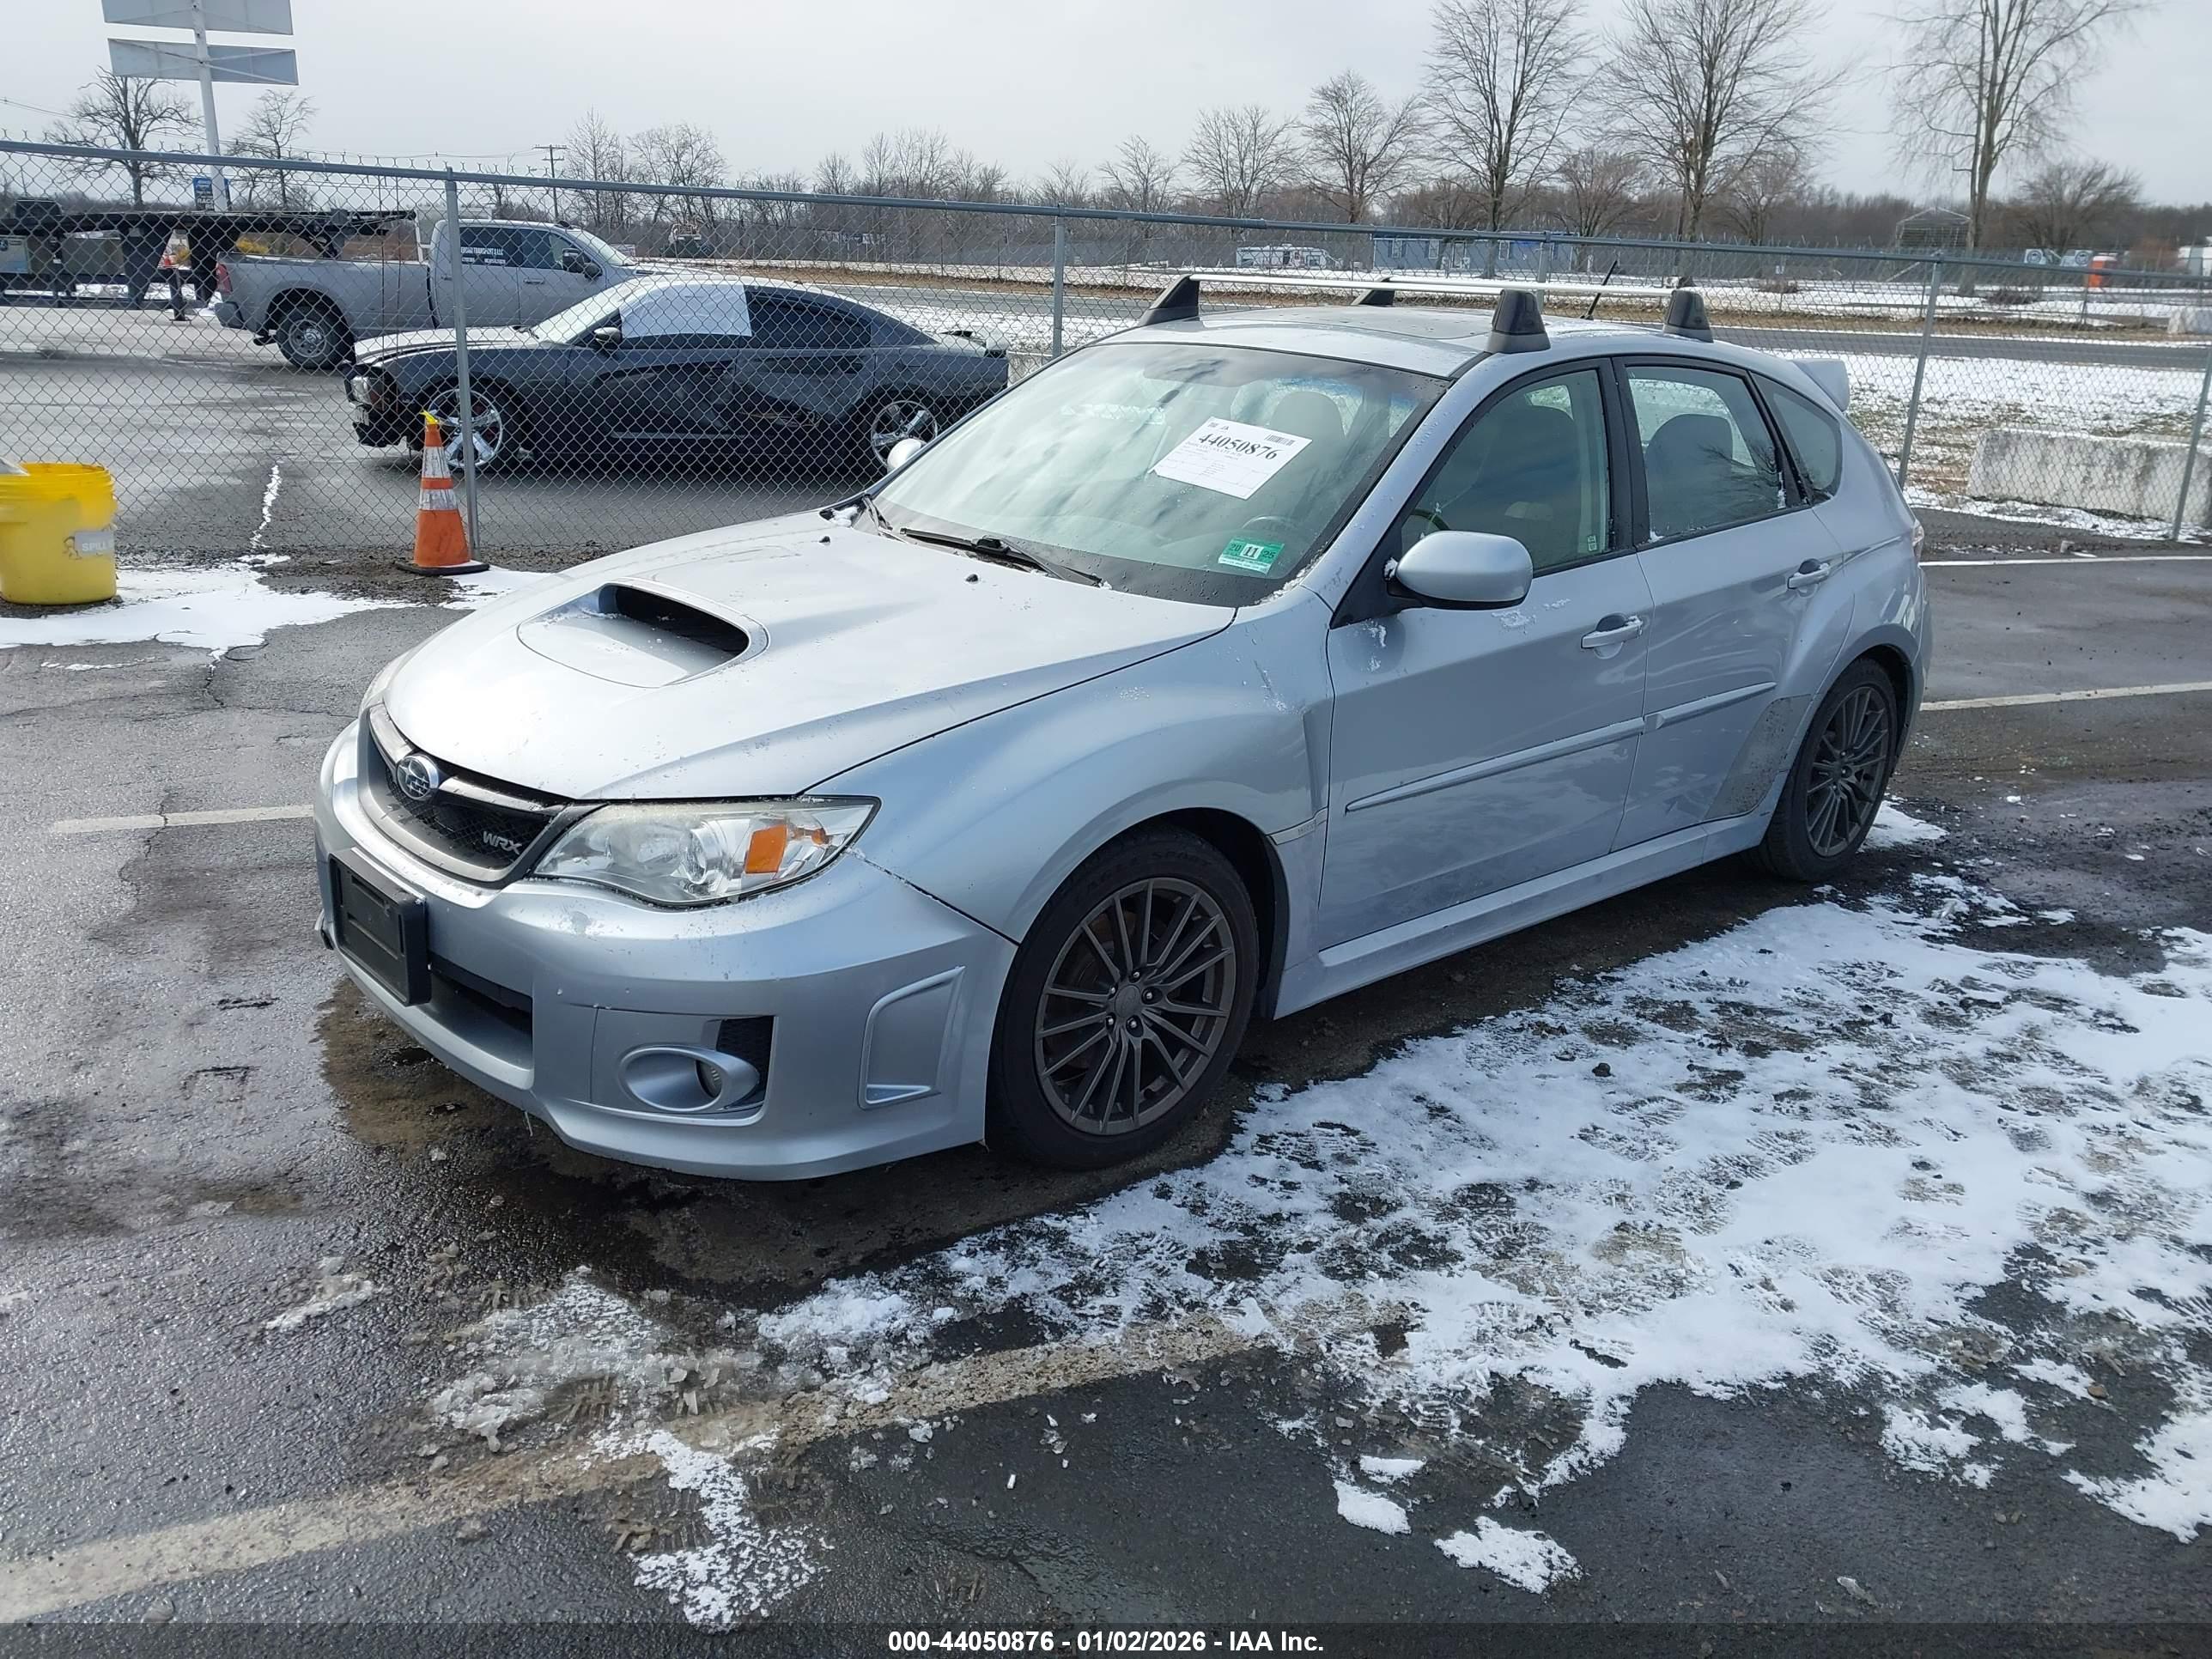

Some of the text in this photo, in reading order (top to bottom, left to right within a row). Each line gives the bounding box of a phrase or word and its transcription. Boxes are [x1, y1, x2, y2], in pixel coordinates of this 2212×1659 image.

[1199, 433, 1282, 460] 44050876
[1229, 543, 1243, 552] 20
[1243, 546, 1259, 558] 11
[1262, 550, 1277, 559] 25
[483, 830, 523, 855] WRX
